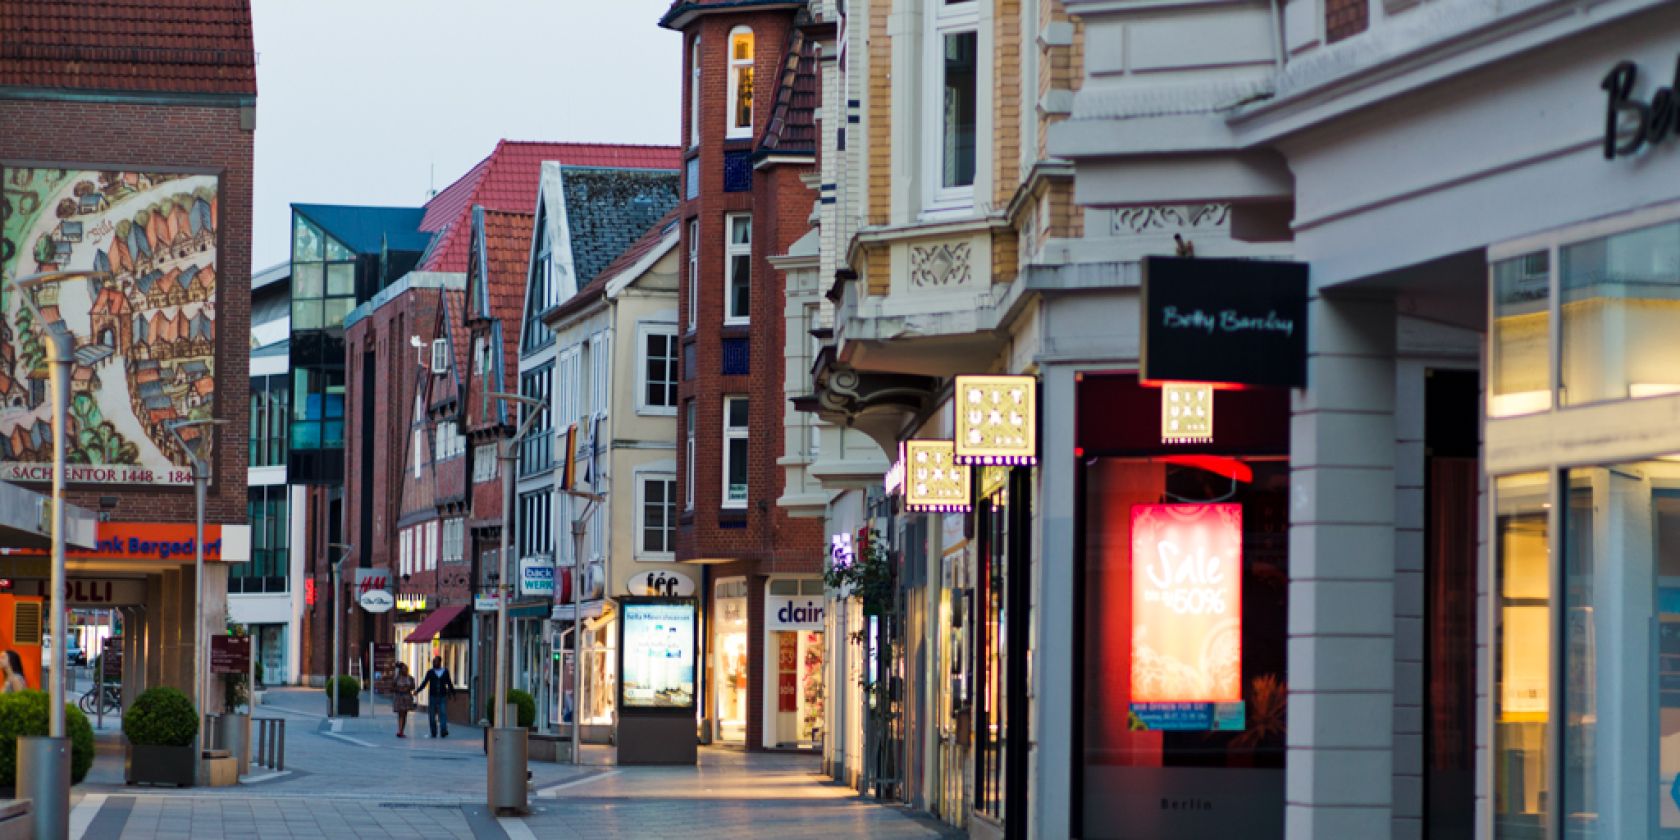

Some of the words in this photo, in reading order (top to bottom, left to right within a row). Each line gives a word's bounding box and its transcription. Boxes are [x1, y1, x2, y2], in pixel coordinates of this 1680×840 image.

[1163, 305, 1214, 335] Betty
[1220, 309, 1293, 337] Barclay
[12, 467, 117, 482] SACHENTOR
[121, 469, 153, 482] 1448
[168, 470, 193, 483] 184
[128, 537, 221, 557] Bergedrf
[525, 567, 552, 577] back
[1146, 540, 1224, 588] Sale
[525, 580, 553, 589] WERK
[778, 601, 824, 623] clair
[1160, 798, 1212, 810] Berlin
